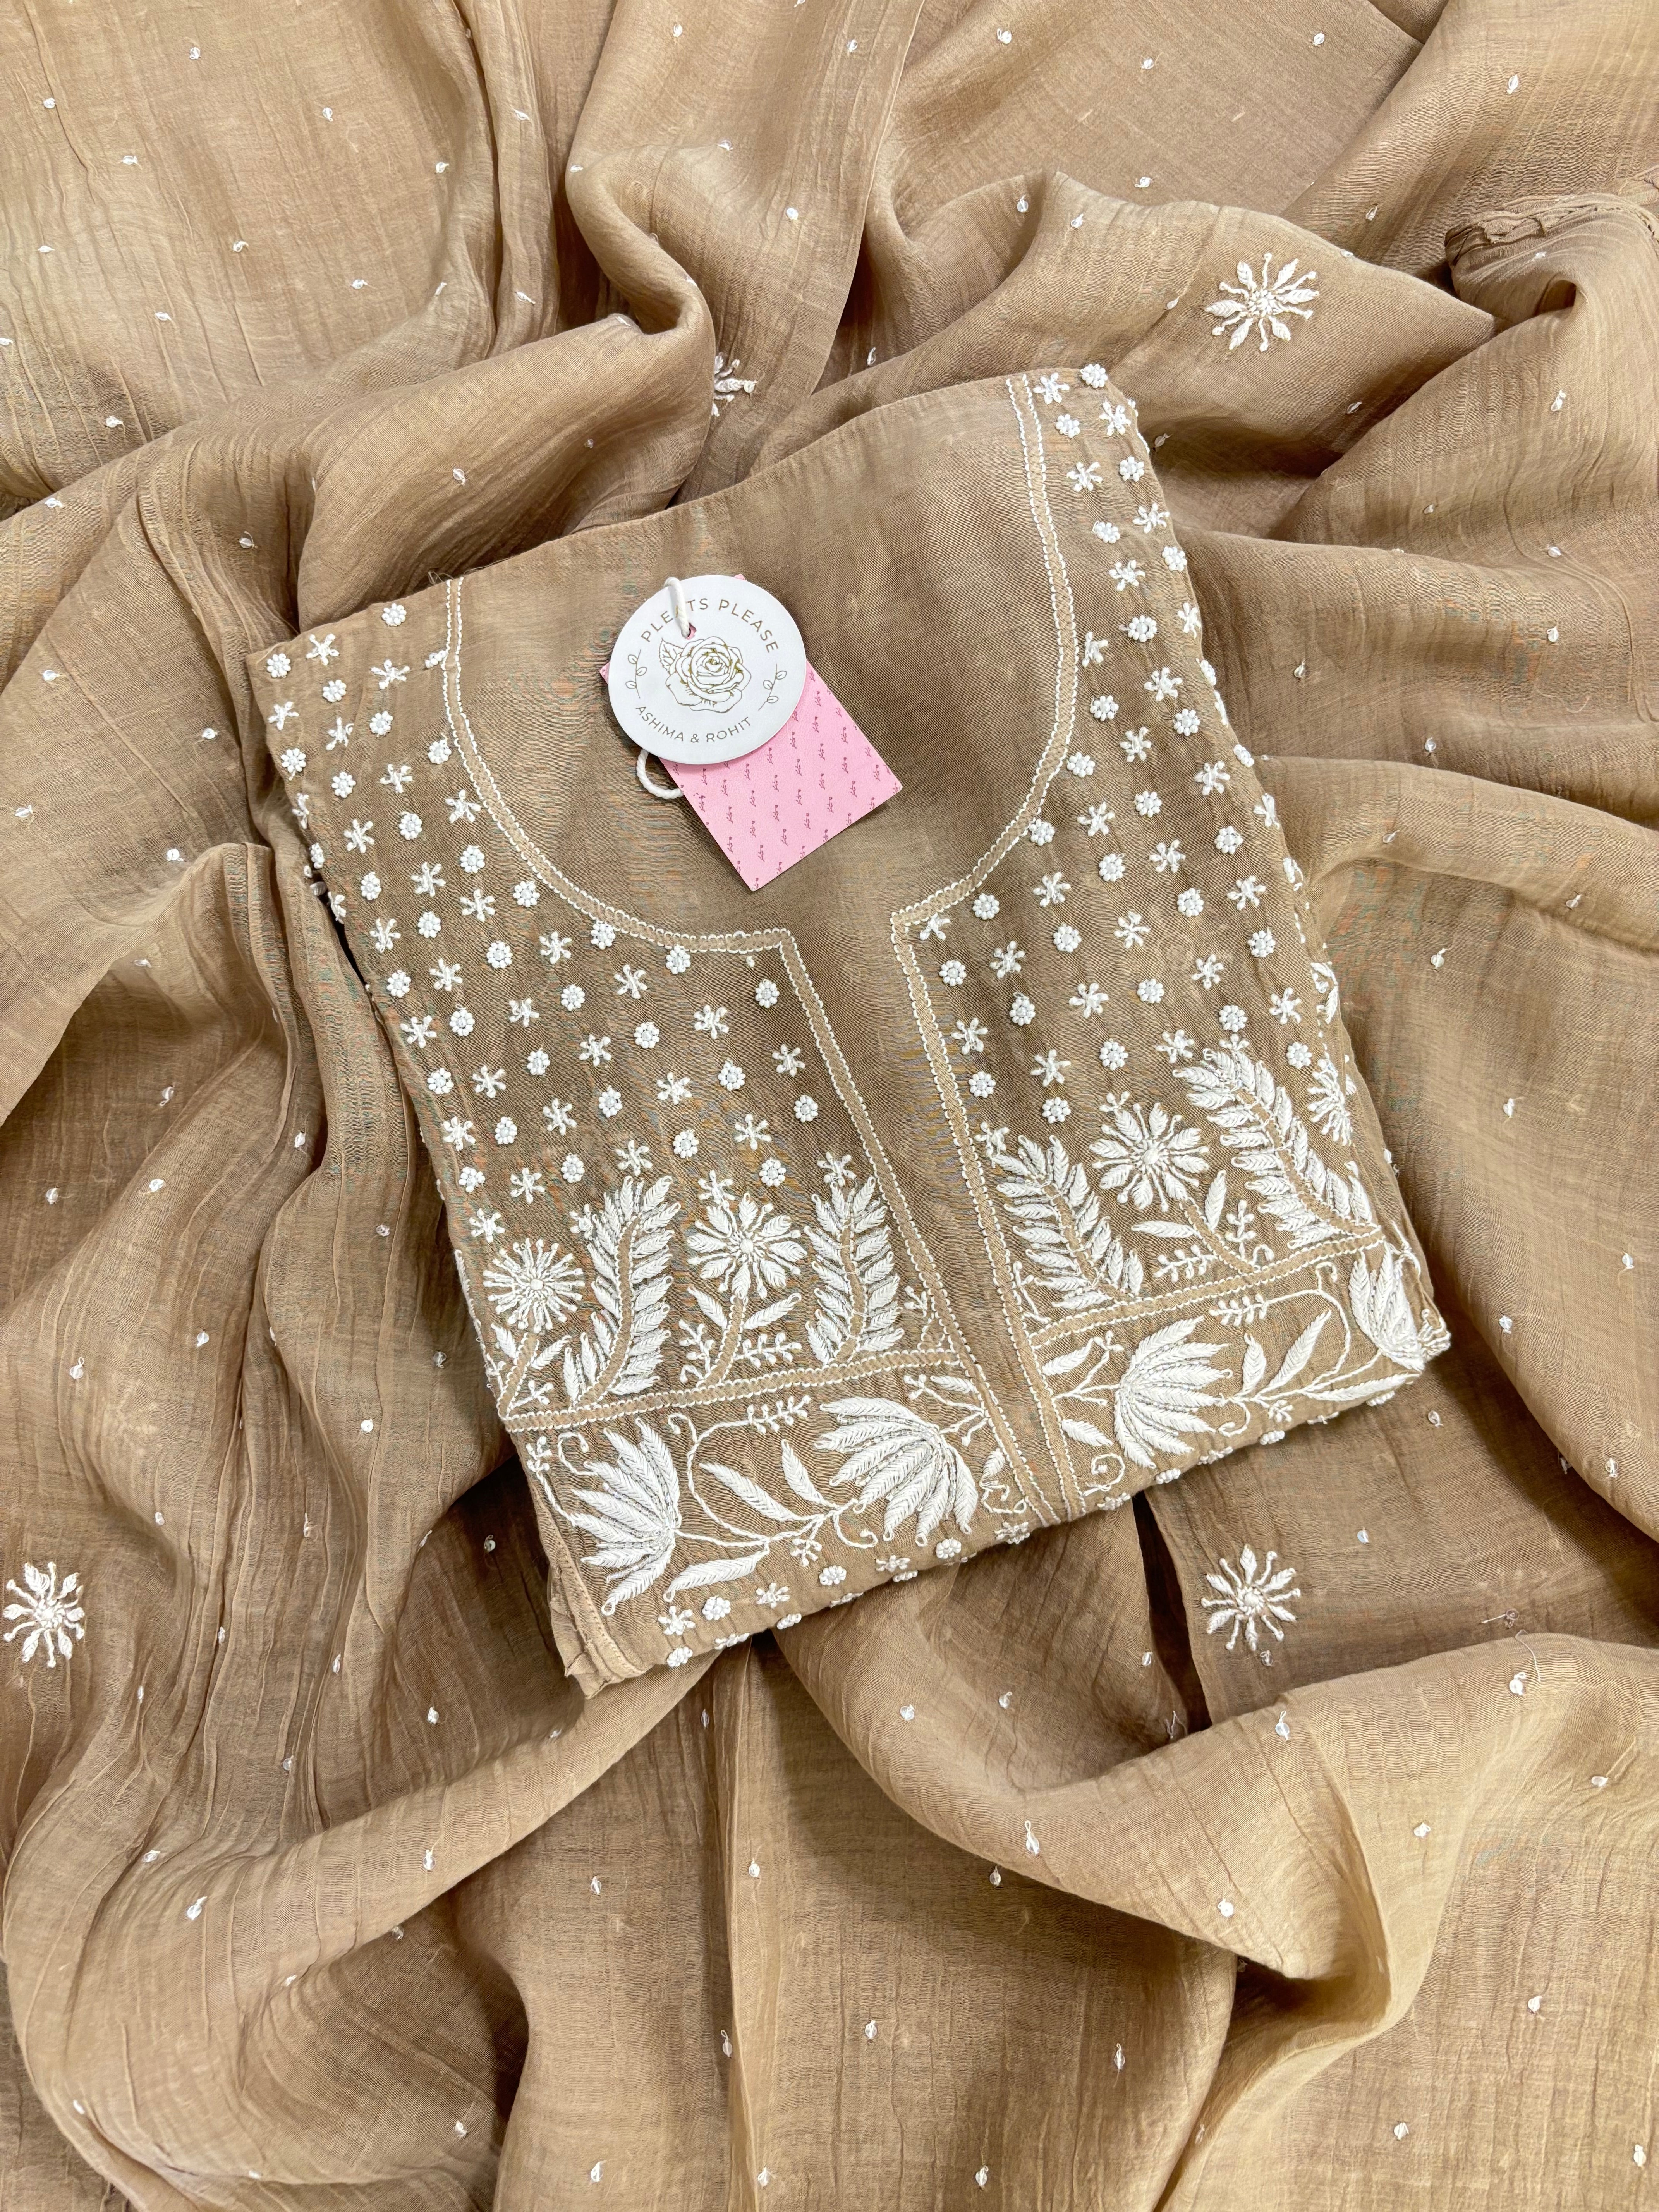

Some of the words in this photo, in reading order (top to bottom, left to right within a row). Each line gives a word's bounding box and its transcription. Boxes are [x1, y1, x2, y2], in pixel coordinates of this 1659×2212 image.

[641, 598, 709, 642] PLETS
[719, 599, 778, 653] PLEASE
[635, 706, 684, 742] ASHIMA
[691, 734, 699, 743] &
[706, 717, 751, 742] ROHIT
